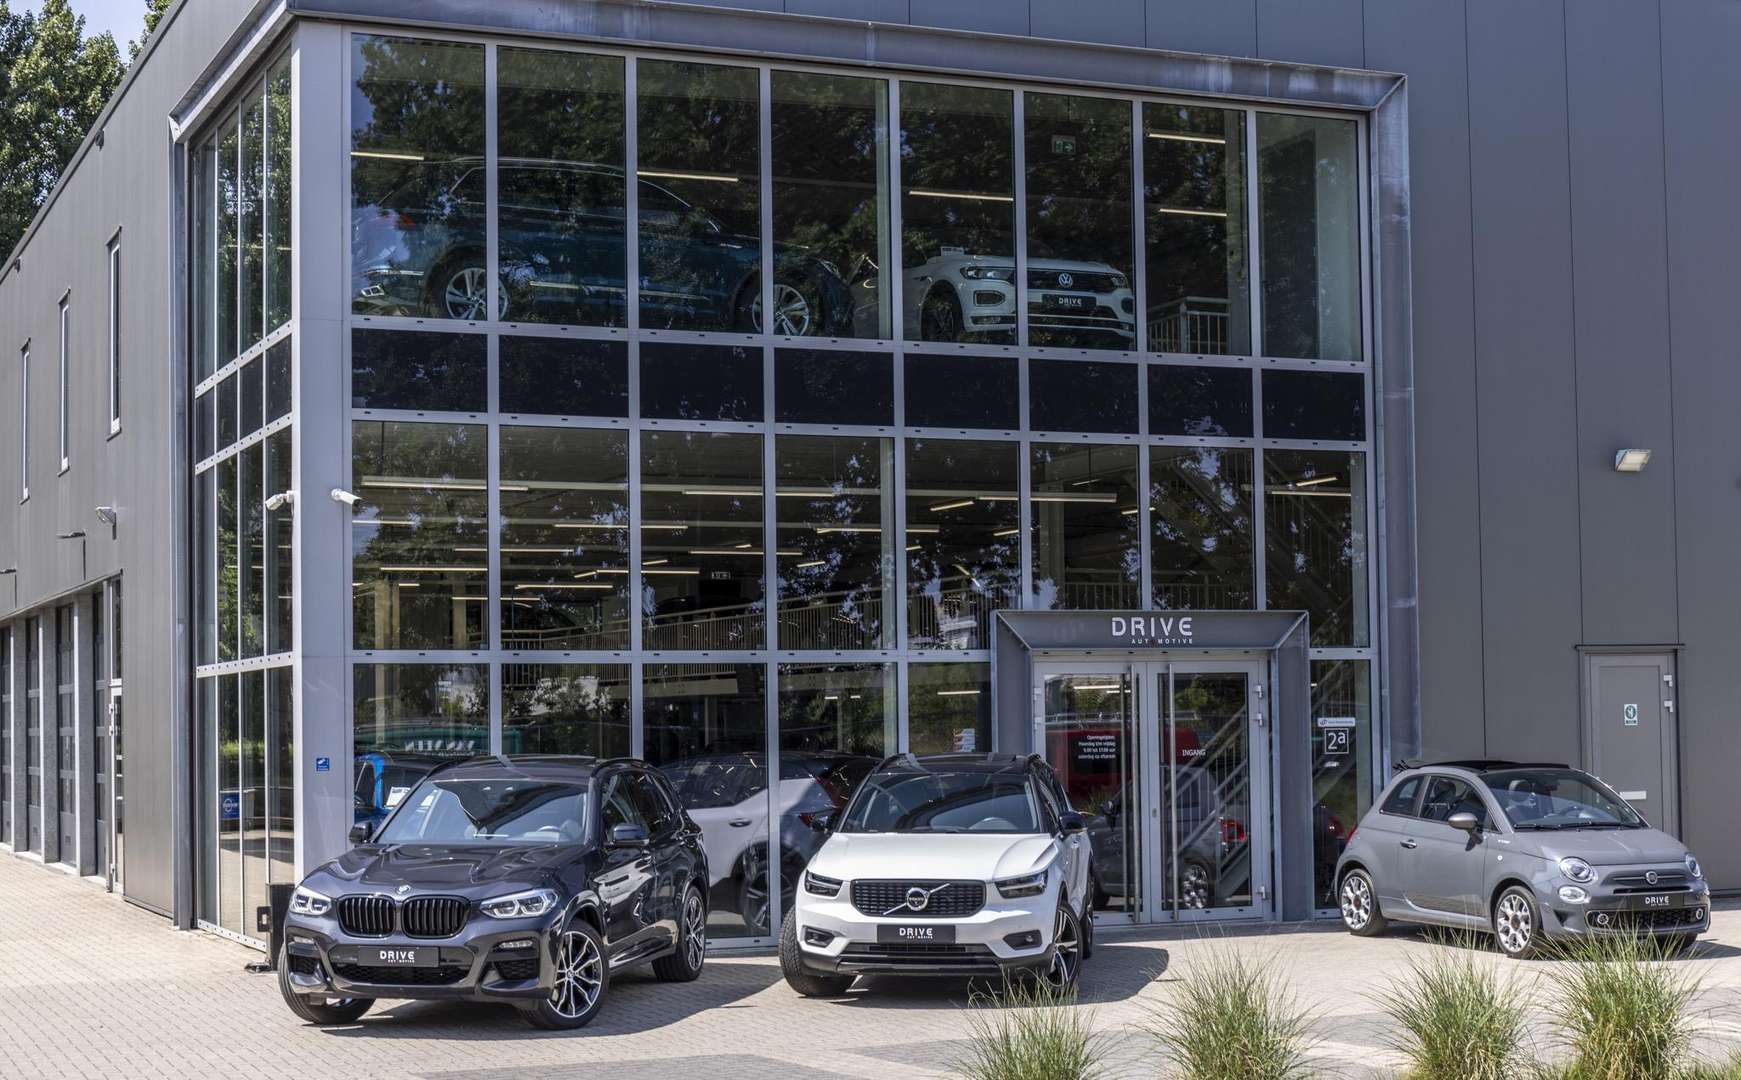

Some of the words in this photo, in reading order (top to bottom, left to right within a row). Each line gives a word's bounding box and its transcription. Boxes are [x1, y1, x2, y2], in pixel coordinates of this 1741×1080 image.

[1111, 617, 1193, 637] DRIVE
[1327, 732, 1346, 750] 2a
[1182, 749, 1206, 757] INGANG
[1644, 895, 1670, 905] DRIVE
[899, 927, 933, 936] DRIVE
[379, 950, 415, 960] DRIVE
